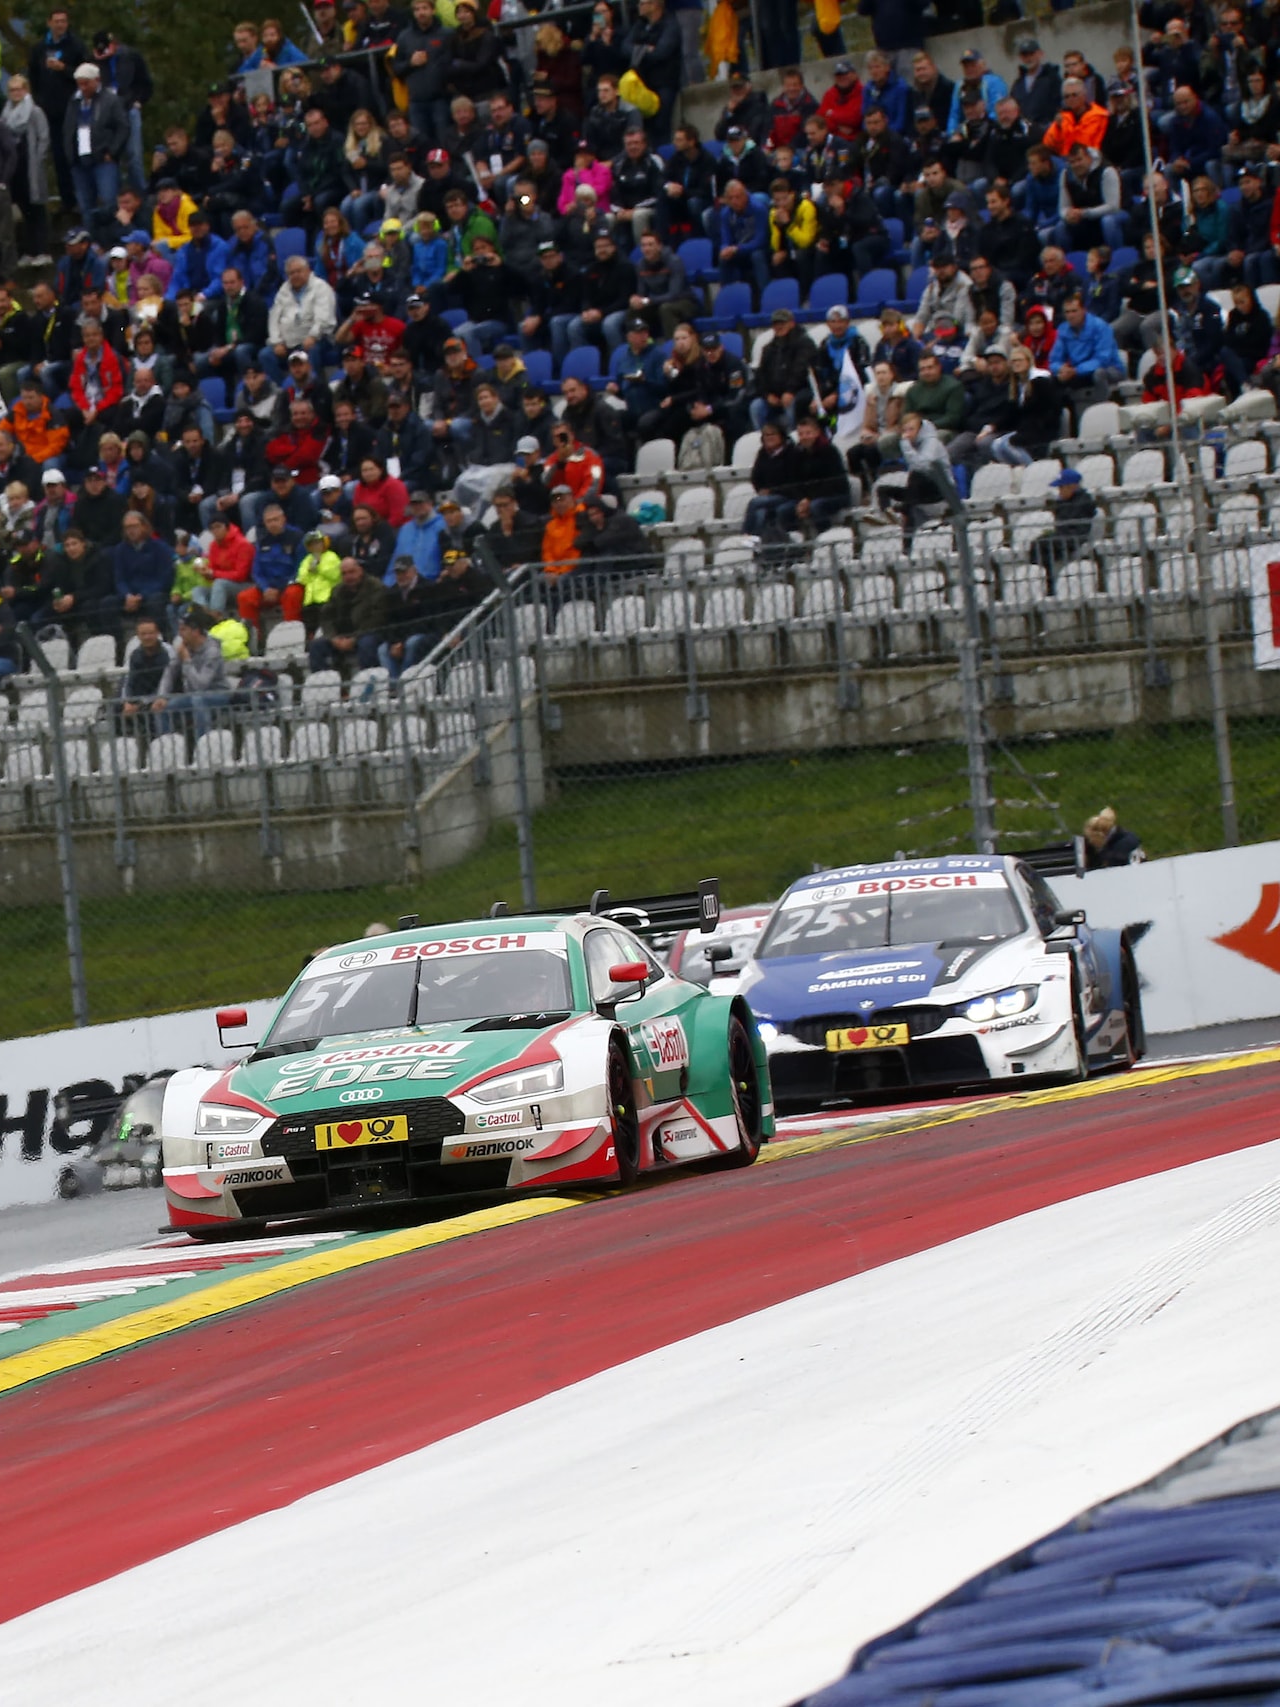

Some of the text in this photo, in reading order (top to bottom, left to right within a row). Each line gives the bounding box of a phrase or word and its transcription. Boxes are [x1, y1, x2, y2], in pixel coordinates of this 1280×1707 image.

[807, 860, 992, 884] SAMSUNG SDI
[857, 875, 977, 895] BOSCH
[770, 901, 851, 947] 25
[391, 934, 526, 960] BOSCH
[286, 971, 375, 1018] 51
[807, 974, 927, 993] SAMSUNG SDI
[323, 1043, 455, 1064] Castrol
[264, 1058, 467, 1101] EDGE
[487, 1111, 521, 1126] Castrol
[224, 1143, 250, 1157] Castrol
